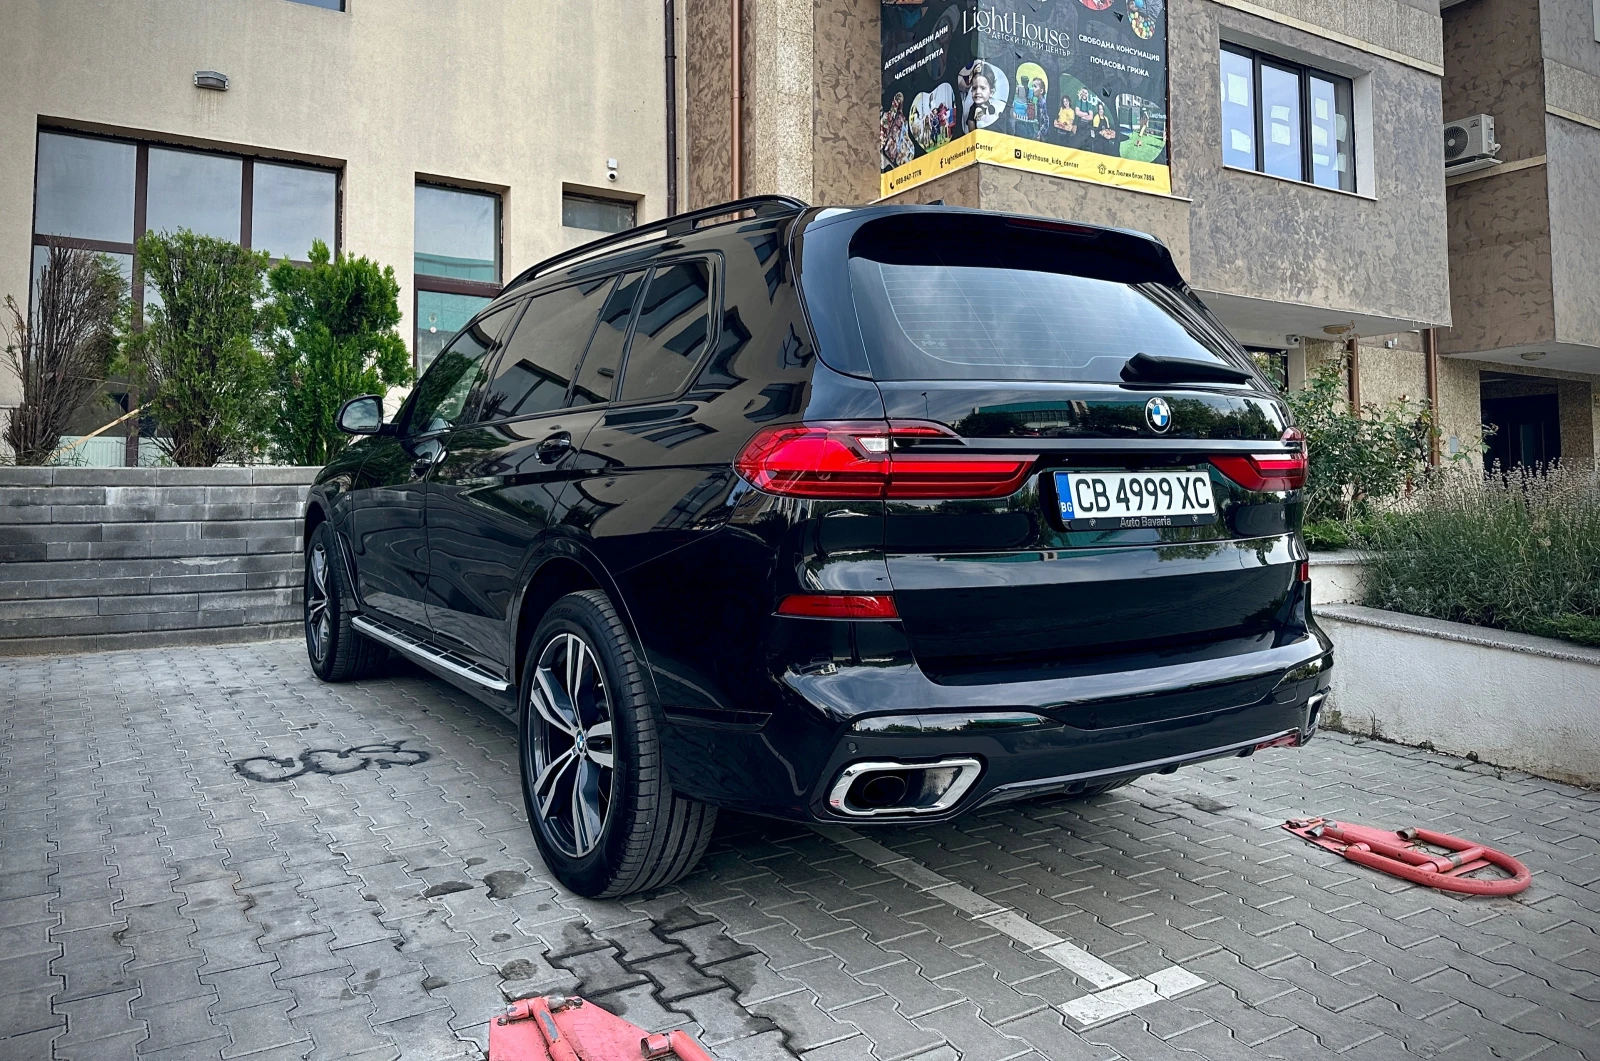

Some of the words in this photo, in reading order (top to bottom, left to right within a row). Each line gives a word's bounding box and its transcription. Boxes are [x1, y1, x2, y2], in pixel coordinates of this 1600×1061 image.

[962, 6, 1070, 49] LightHouse
[884, 51, 905, 70] ДЕТСКИ
[905, 33, 934, 56] РОЖДЕНИ
[934, 25, 949, 40] ДНИ
[991, 31, 1020, 44] ДЕТСКИ
[1021, 38, 1044, 51] ПАРТИ
[1045, 45, 1071, 57] ЦЕНТЪР
[1078, 34, 1115, 51] СВОБОДНА
[1116, 44, 1160, 62] КОНСУМАЦИЯ
[894, 64, 917, 80] ЧАСТНИ
[917, 47, 944, 68] ПАРТИТА
[1090, 56, 1126, 71] ПОЧАСОВА
[1126, 65, 1150, 77] ГРИЖА
[975, 142, 993, 152] Center
[1060, 501, 1073, 513] BG
[1075, 477, 1111, 513] CB
[1115, 476, 1173, 512] 4999
[1176, 476, 1210, 510] XC
[1119, 516, 1141, 528] Auto
[1141, 515, 1172, 528] Bavaria
